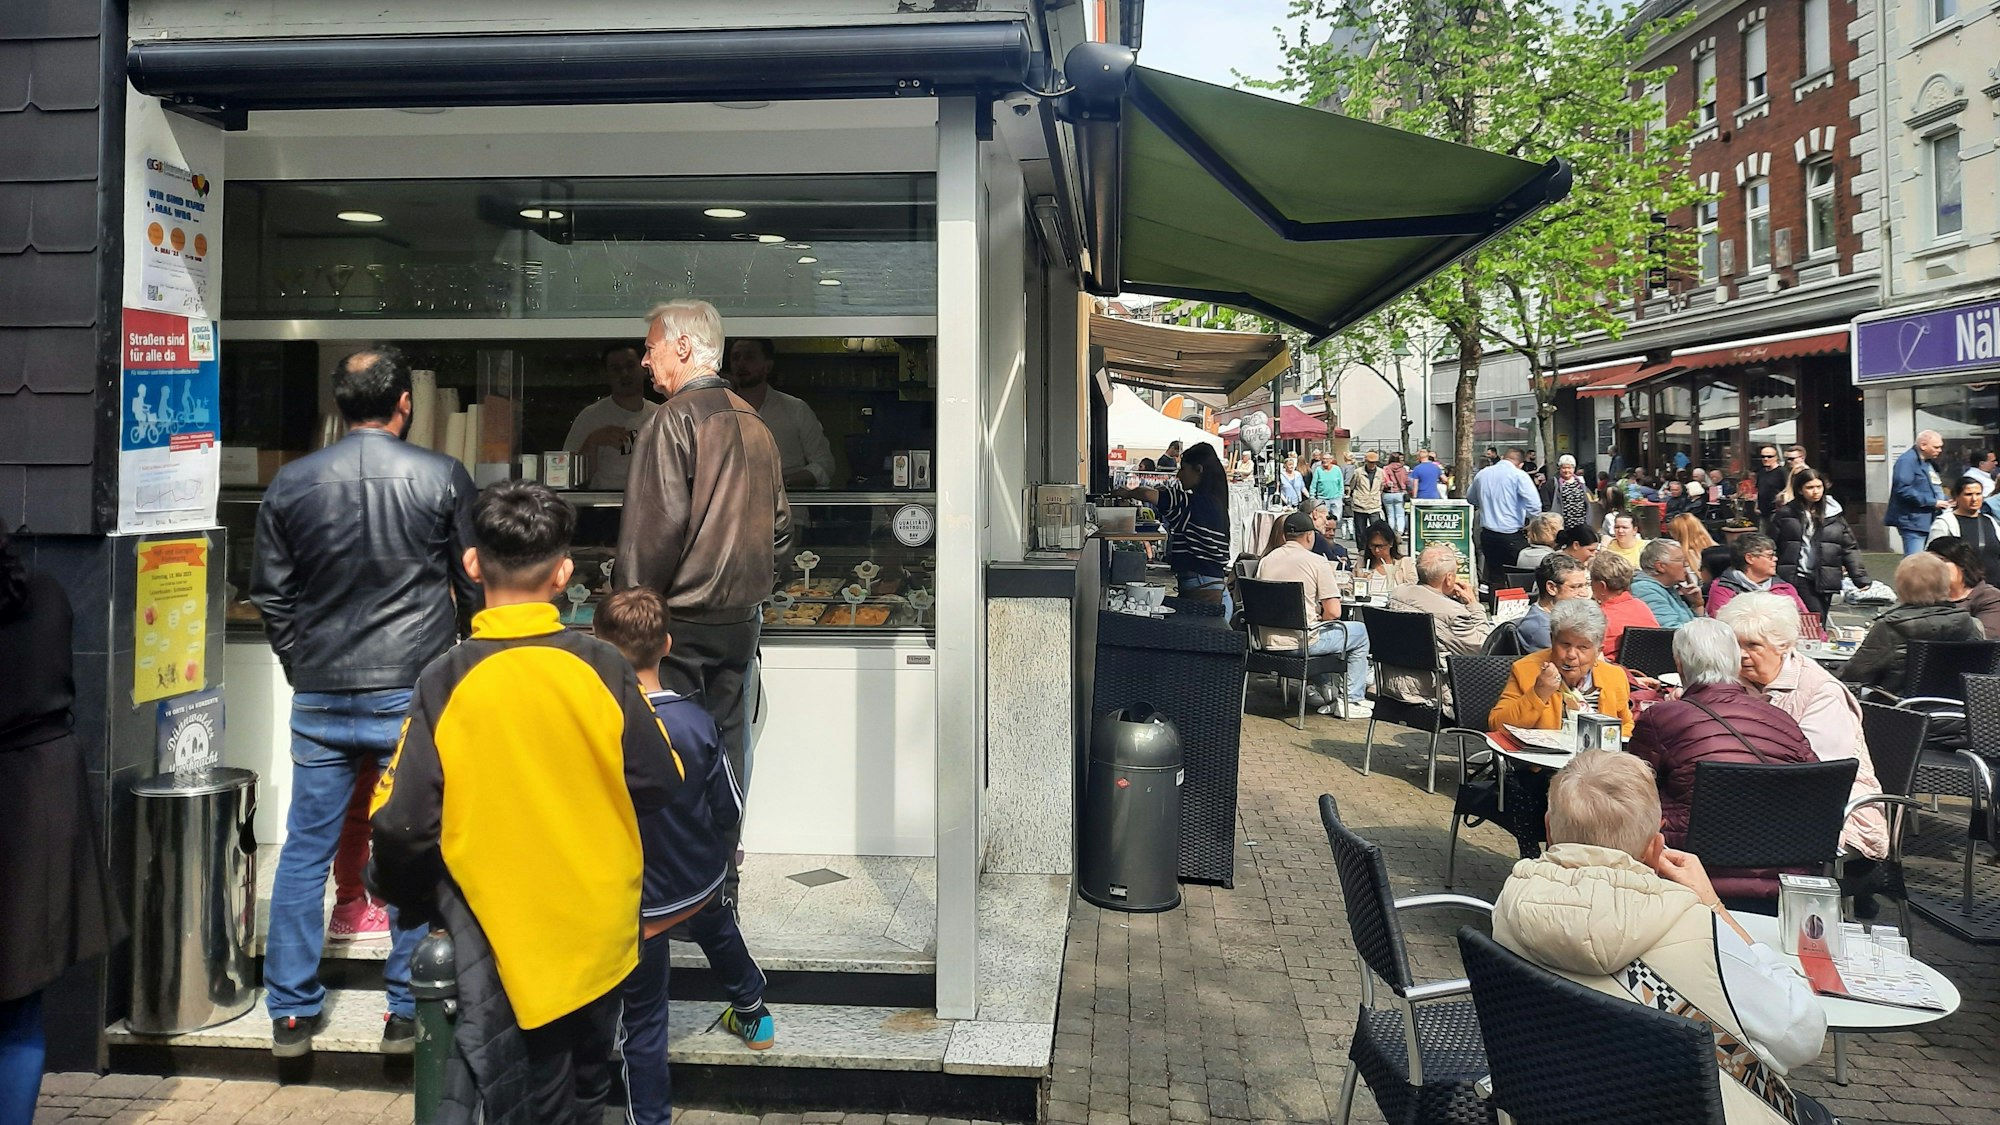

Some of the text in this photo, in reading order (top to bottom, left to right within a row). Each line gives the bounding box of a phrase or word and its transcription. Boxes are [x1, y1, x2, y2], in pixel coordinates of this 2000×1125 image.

[149, 188, 164, 201] WIR
[185, 199, 206, 213] KURZ
[155, 203, 173, 216] MAL
[174, 208, 191, 221] WEG
[129, 332, 186, 346] Straßen sind
[129, 347, 177, 362] für alle da
[1424, 514, 1462, 522] ALTGOLD-
[166, 712, 215, 753] Dünnwalder
